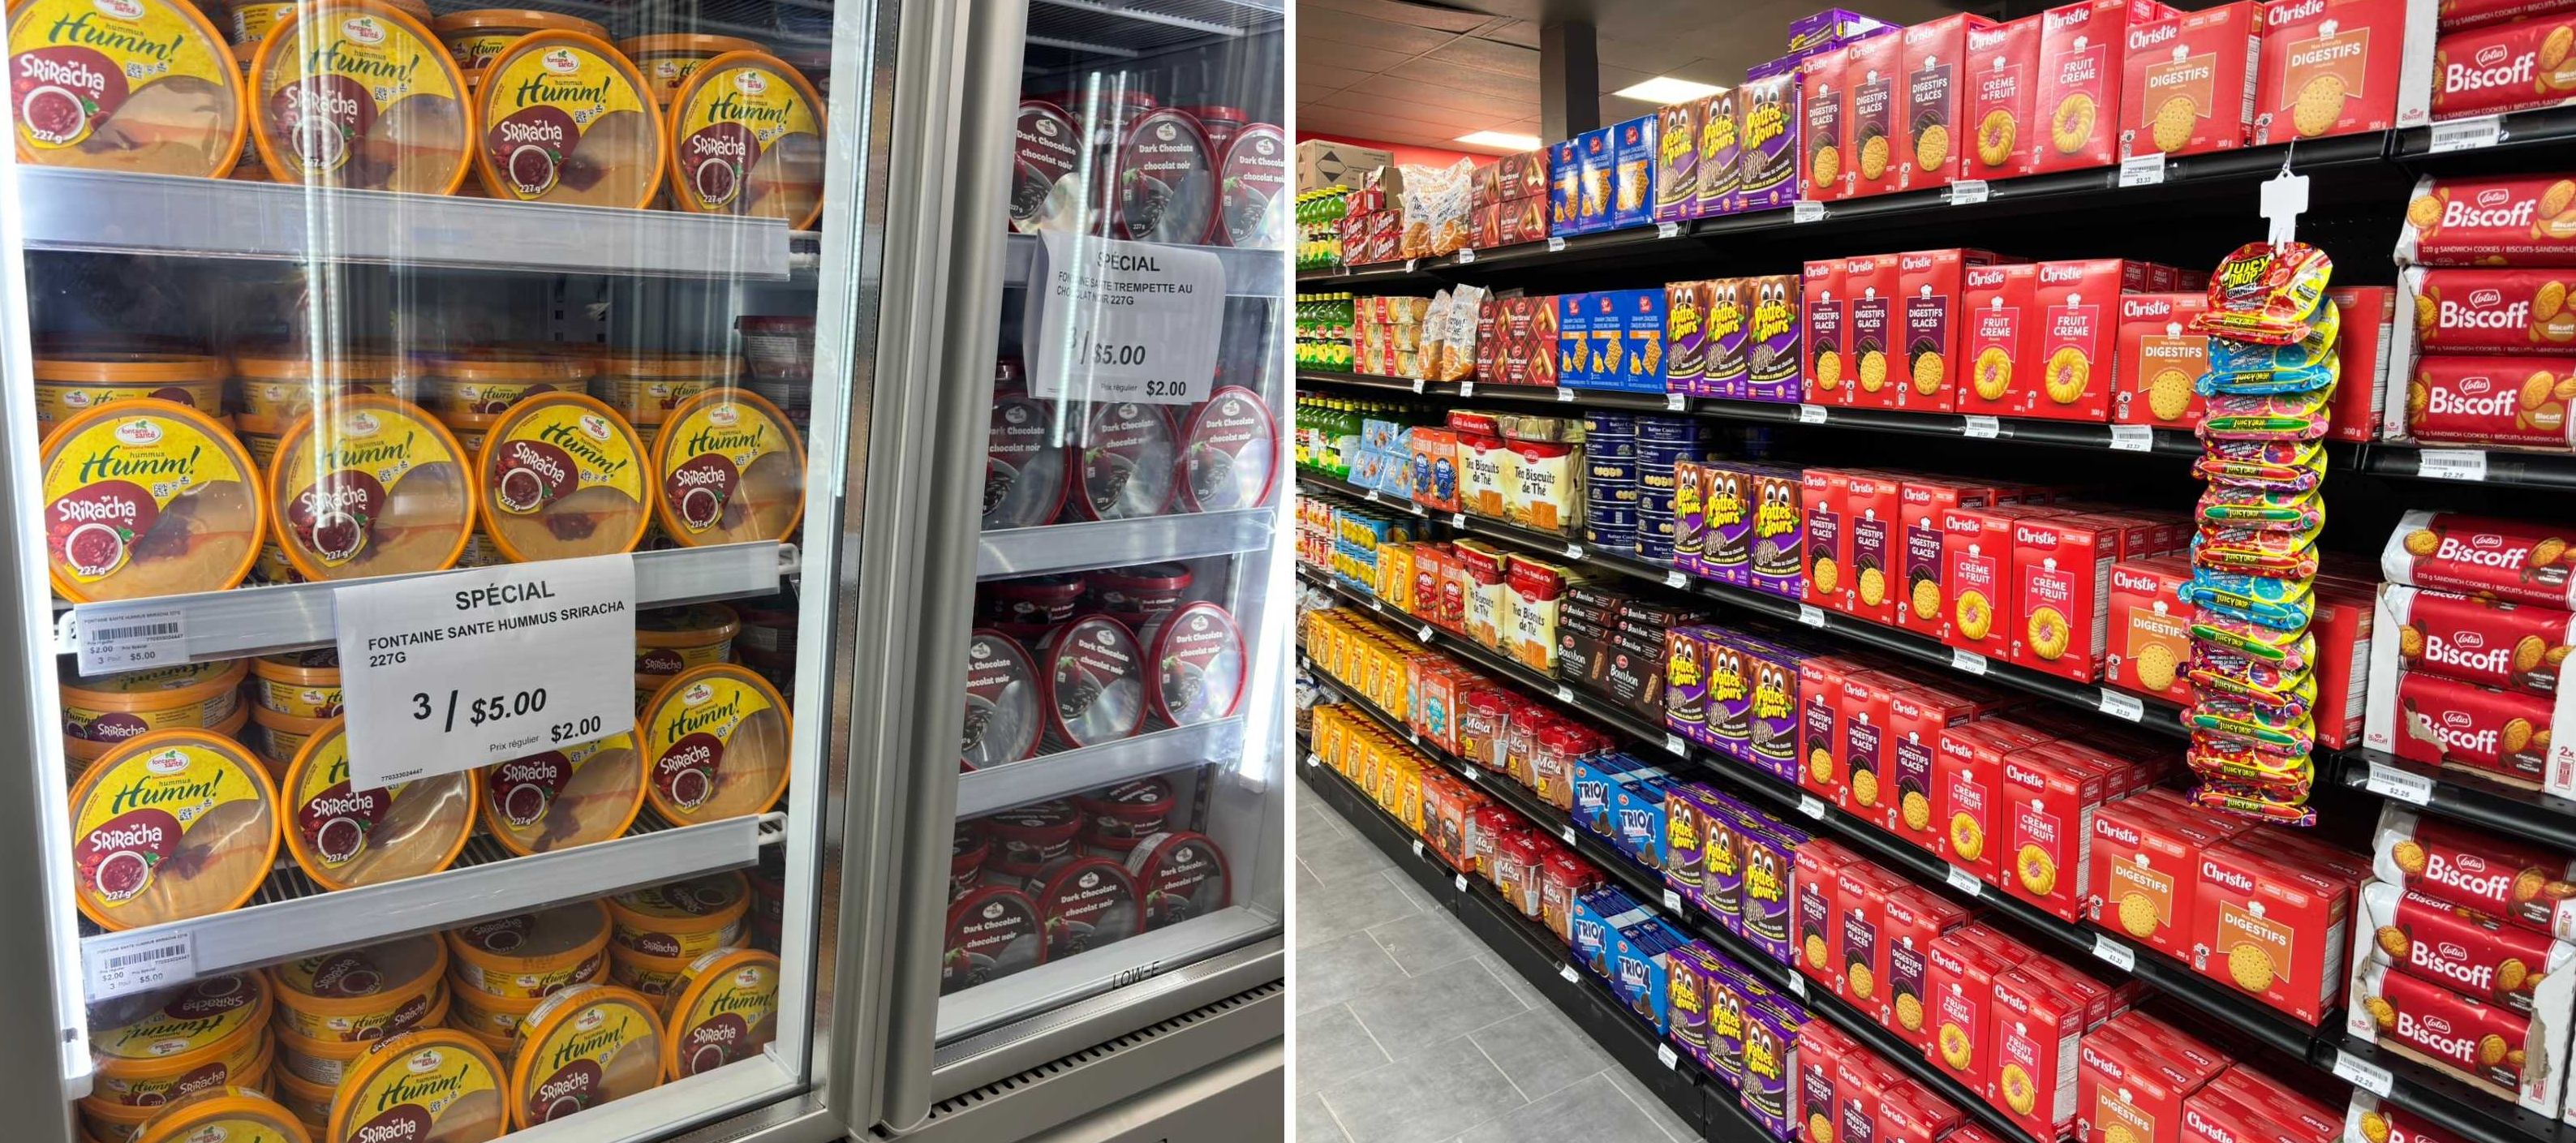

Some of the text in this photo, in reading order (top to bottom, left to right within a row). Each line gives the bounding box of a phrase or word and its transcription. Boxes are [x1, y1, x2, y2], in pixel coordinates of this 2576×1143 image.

[2046, 8, 2089, 32] Christie
[2269, 1, 2324, 26] Christie
[49, 13, 184, 64] Humm!
[105, 24, 144, 37] hummus
[1969, 30, 2006, 50] Christie
[2129, 25, 2178, 49] Christie
[2063, 58, 2094, 72] FRUIT
[2292, 43, 2360, 67] DIGESTIFS
[2150, 67, 2208, 88] DIGESTIFS
[2445, 51, 2536, 93] Biscoff
[516, 73, 611, 108] Humm!
[1912, 78, 1947, 93] DIGESTIFS
[1983, 77, 2015, 92] CRÈME
[1989, 86, 2015, 99] FRUIT
[1915, 90, 1942, 102] GLACÉS
[708, 92, 792, 125] Humm!
[32, 129, 54, 140] 227
[1017, 131, 1076, 156] Dark Chocolate
[1139, 144, 1193, 153] Dark Chocolate
[1021, 148, 1073, 170] chocolat noir
[1144, 161, 1190, 170] chocolat noir
[519, 184, 535, 193] 227
[2442, 200, 2536, 228] Biscoff
[1902, 256, 1932, 269] Christie
[1968, 270, 2005, 286] Christie
[2040, 266, 2083, 283] Christie
[2230, 269, 2258, 289] DROP
[1114, 281, 1193, 294] TREMPETTE AU
[1111, 295, 1134, 305] 227G
[2123, 299, 2170, 317] Christie
[1908, 308, 1942, 318] DIGESTIFS
[1912, 317, 1937, 328] GLACÉS
[1984, 318, 2009, 327] FRUIT
[2058, 316, 2087, 326] FRUIT
[2440, 300, 2529, 329] Biscoff
[1980, 326, 2010, 337] CREME
[2053, 325, 2088, 336] CREME
[1094, 345, 1146, 365] $5.00
[2145, 346, 2202, 358] DIGESTIFS
[1146, 380, 1186, 397] $2.00
[2429, 387, 2517, 416] Biscoff
[1206, 417, 1254, 428] Dark Chocolate
[689, 423, 763, 456] Humm!
[1210, 432, 1251, 444] chocolat noir
[130, 450, 165, 458] hummus
[540, 421, 628, 478] Humm!
[80, 445, 200, 483] Humm!
[1515, 466, 1555, 484] Tea Biscuits
[1522, 483, 1546, 496] de Thé
[1946, 515, 1980, 532] Christie
[2017, 526, 2057, 545] Christie
[2436, 537, 2527, 569] Biscoff
[78, 565, 96, 576] 227
[2032, 576, 2066, 591] CRÈME
[2114, 571, 2157, 591] Christie
[455, 581, 555, 611] SPÉCIAL
[2040, 587, 2068, 601] FRUIT
[368, 600, 625, 651] FONTAINE SANTE HUMMUS SRIRACHA
[90, 646, 113, 654] $2.00
[131, 651, 155, 660] $5.00
[369, 651, 406, 668] 227G
[1077, 638, 1129, 662] Dark Chocolate
[2425, 635, 2509, 674] Biscoff
[1080, 655, 1125, 677] chocolat noir
[412, 688, 546, 733] 3 / $5.00
[667, 690, 741, 744] Humm!
[489, 715, 601, 752] Prix régulier $2.00
[1941, 737, 1973, 759] Christie
[158, 779, 191, 787] hummus
[2006, 764, 2044, 788] Christie
[112, 770, 224, 813] Humm!
[1577, 782, 1601, 801] TRIO
[2096, 819, 2139, 845] Christie
[2115, 865, 2168, 893] DIGESTIFS
[2203, 862, 2252, 891] Christie
[2426, 853, 2509, 902] Biscoff
[105, 892, 122, 900] 227
[1060, 883, 1117, 904] Dark Chocolate
[1065, 898, 1114, 917] chocolat noir
[2225, 913, 2286, 946] DIGESTIFS
[1892, 947, 1923, 972] DIGESTIFS
[1931, 947, 1963, 974] Christie
[101, 971, 124, 982] $2.00
[140, 973, 163, 983] $5.00
[1994, 983, 2028, 1013] Christie
[553, 1016, 628, 1070] Humm!
[2398, 1012, 2475, 1063] Biscoff
[2083, 1048, 2123, 1080] Christie
[377, 1064, 468, 1111] Humm!
[2101, 1095, 2149, 1132] DIGESTIFS
